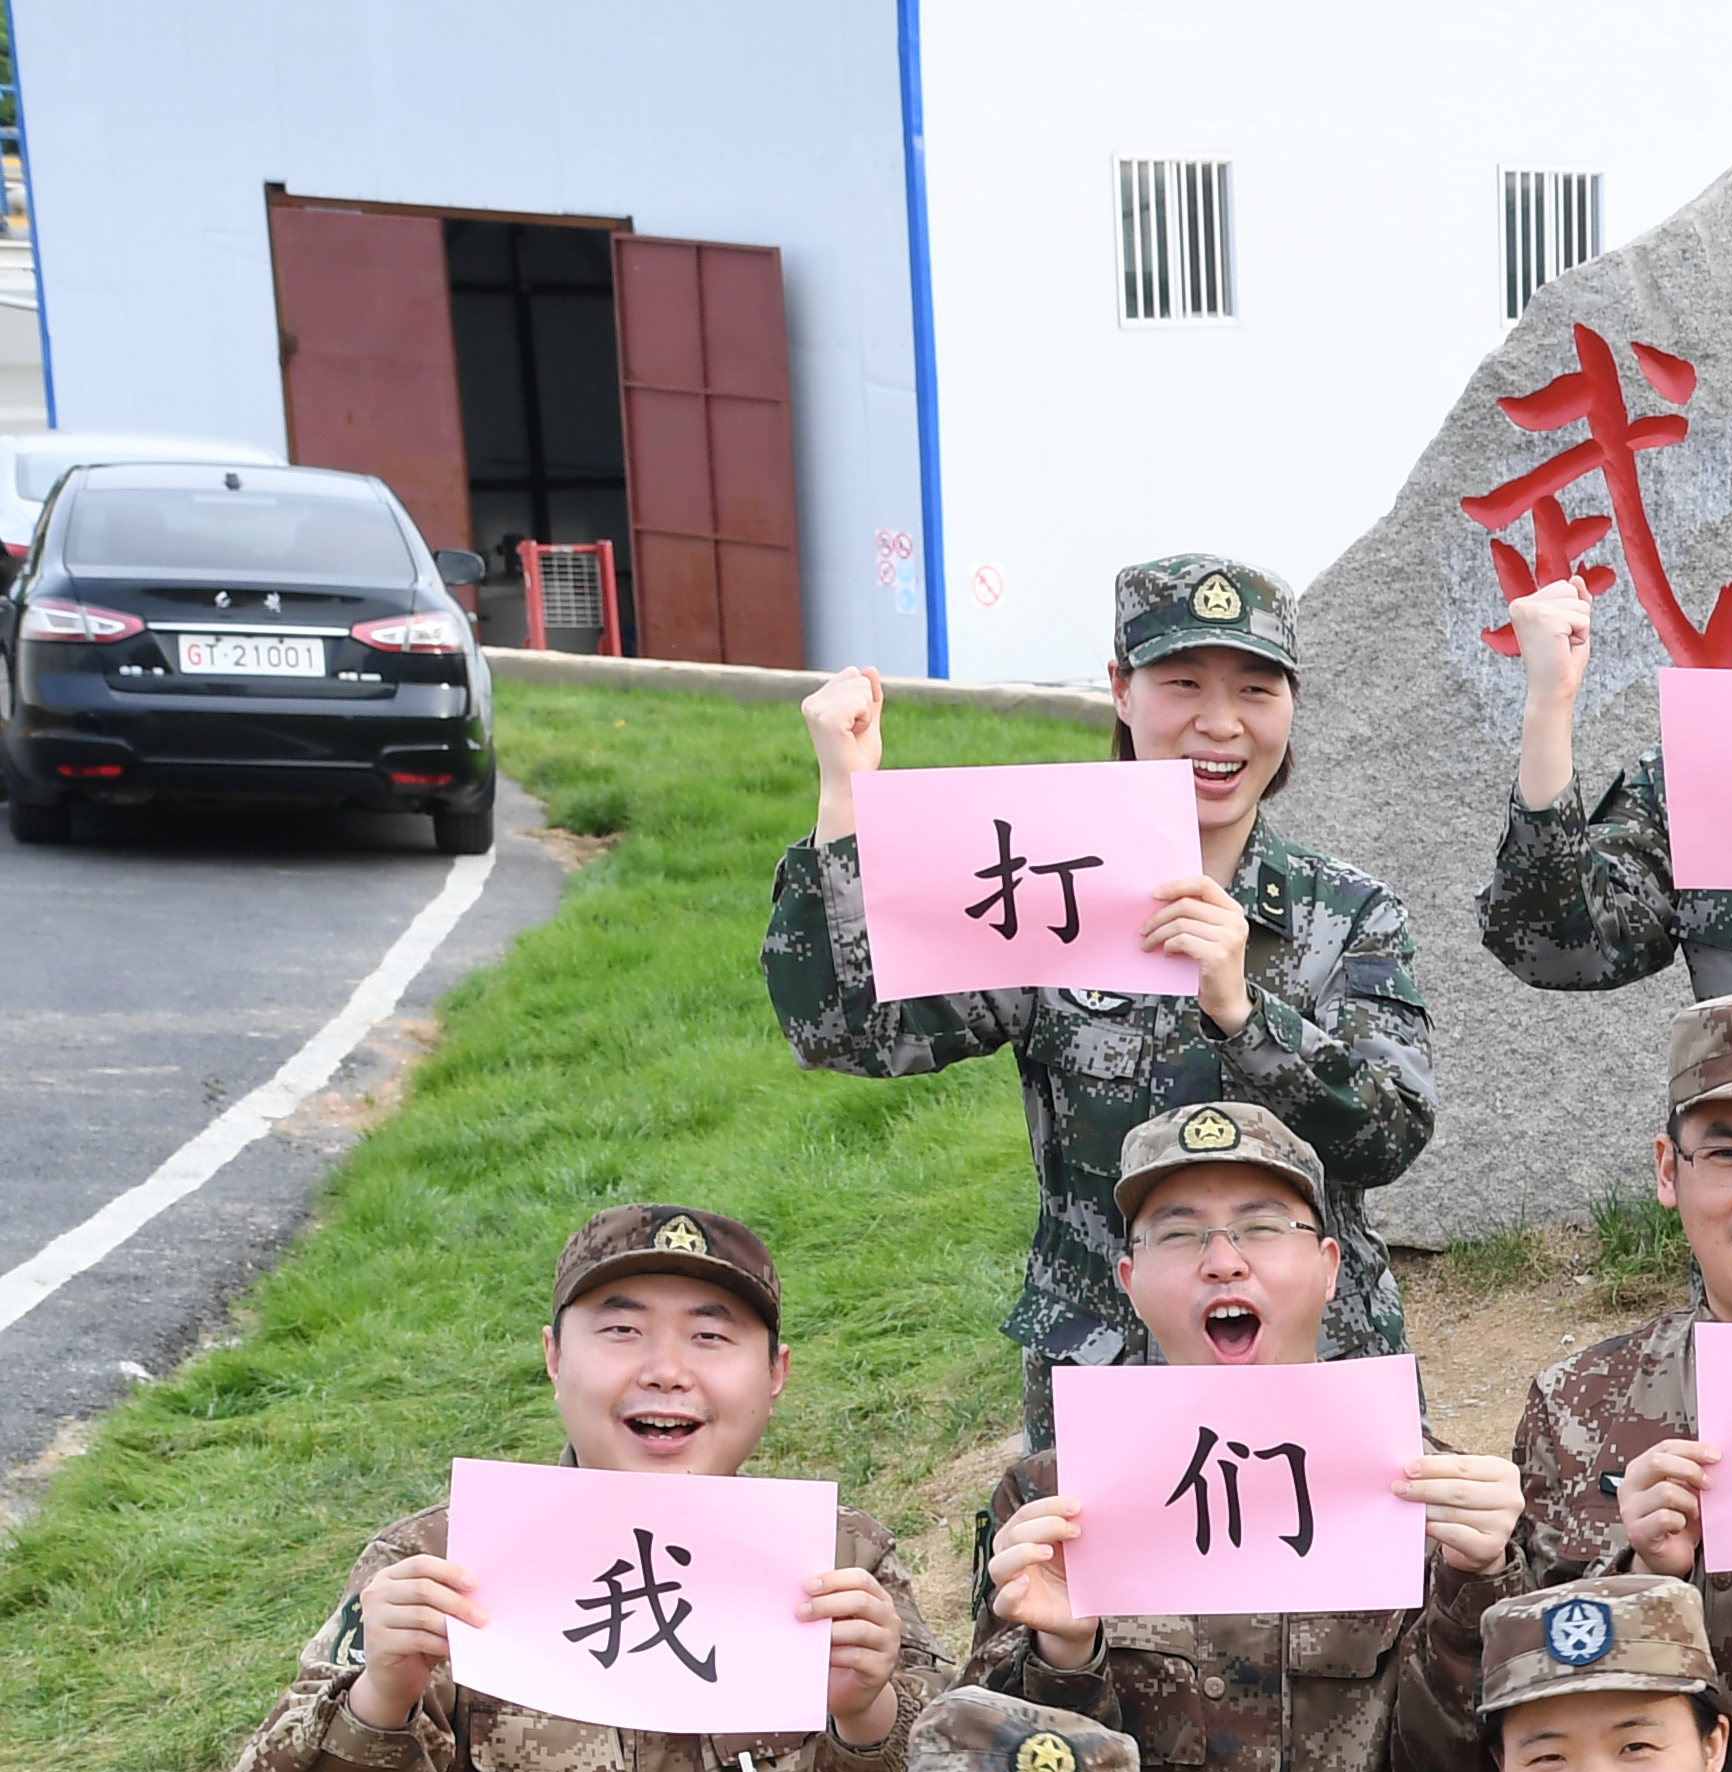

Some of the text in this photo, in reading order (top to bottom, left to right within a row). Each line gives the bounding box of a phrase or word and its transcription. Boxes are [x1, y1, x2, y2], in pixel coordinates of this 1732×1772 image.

[964, 819, 1104, 944] 打
[1165, 1426, 1314, 1557] 们
[562, 1528, 718, 1683] 我
